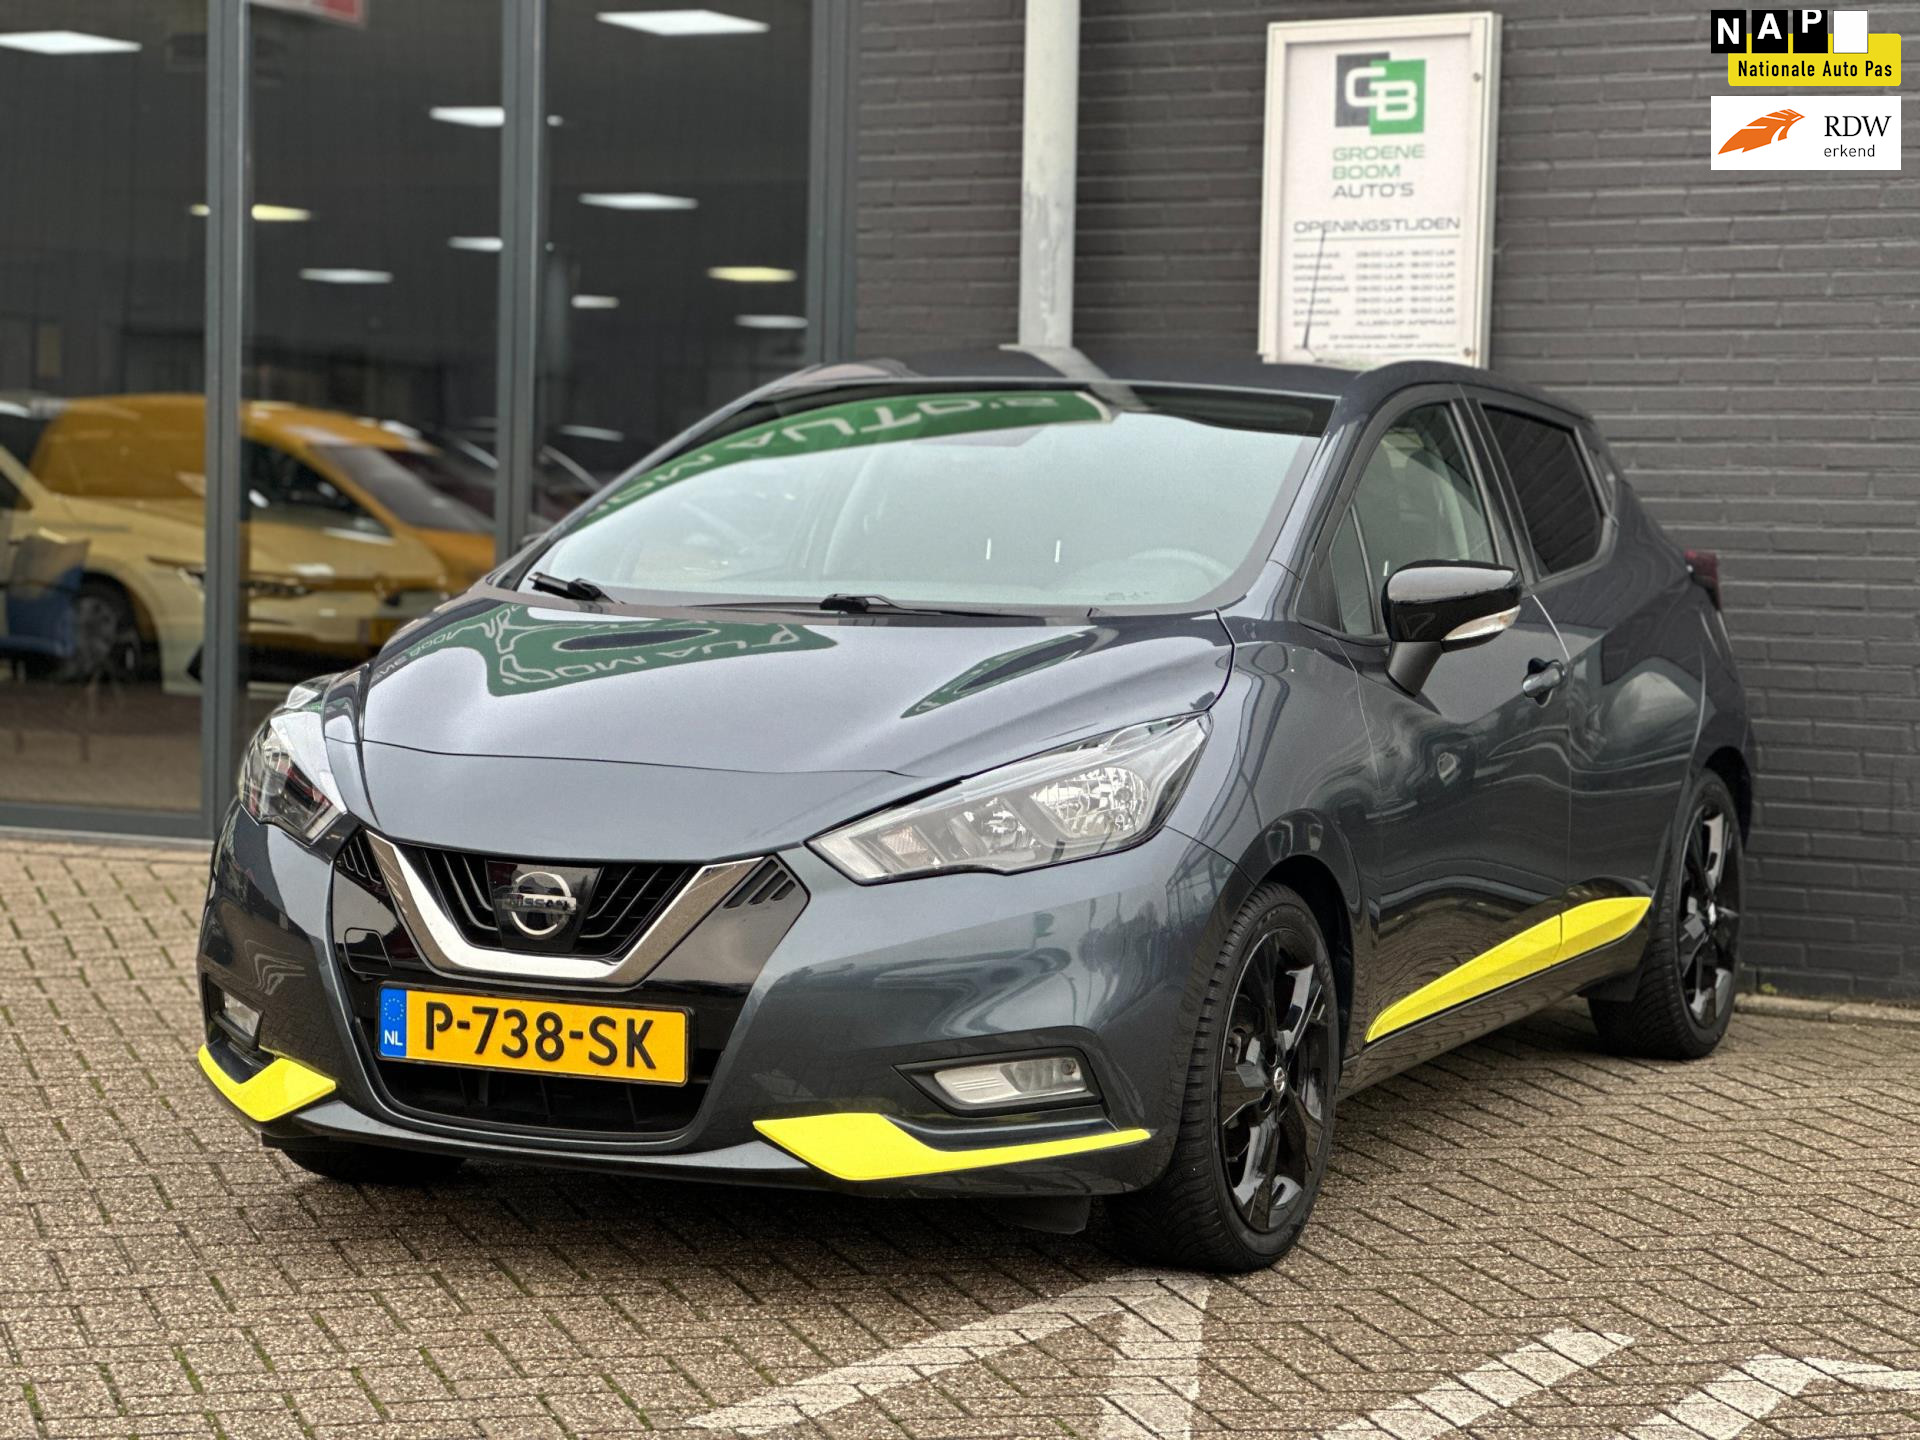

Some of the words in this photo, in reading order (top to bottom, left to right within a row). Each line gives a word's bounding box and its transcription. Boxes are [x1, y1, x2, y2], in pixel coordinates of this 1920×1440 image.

[1332, 144, 1425, 162] GROENE
[1332, 164, 1402, 181] BOOM
[1331, 182, 1416, 199] AUTO'S
[1293, 216, 1461, 234] OPENINGSTIJDEN
[384, 1029, 403, 1047] NL
[424, 1001, 657, 1071] P-738-SK
